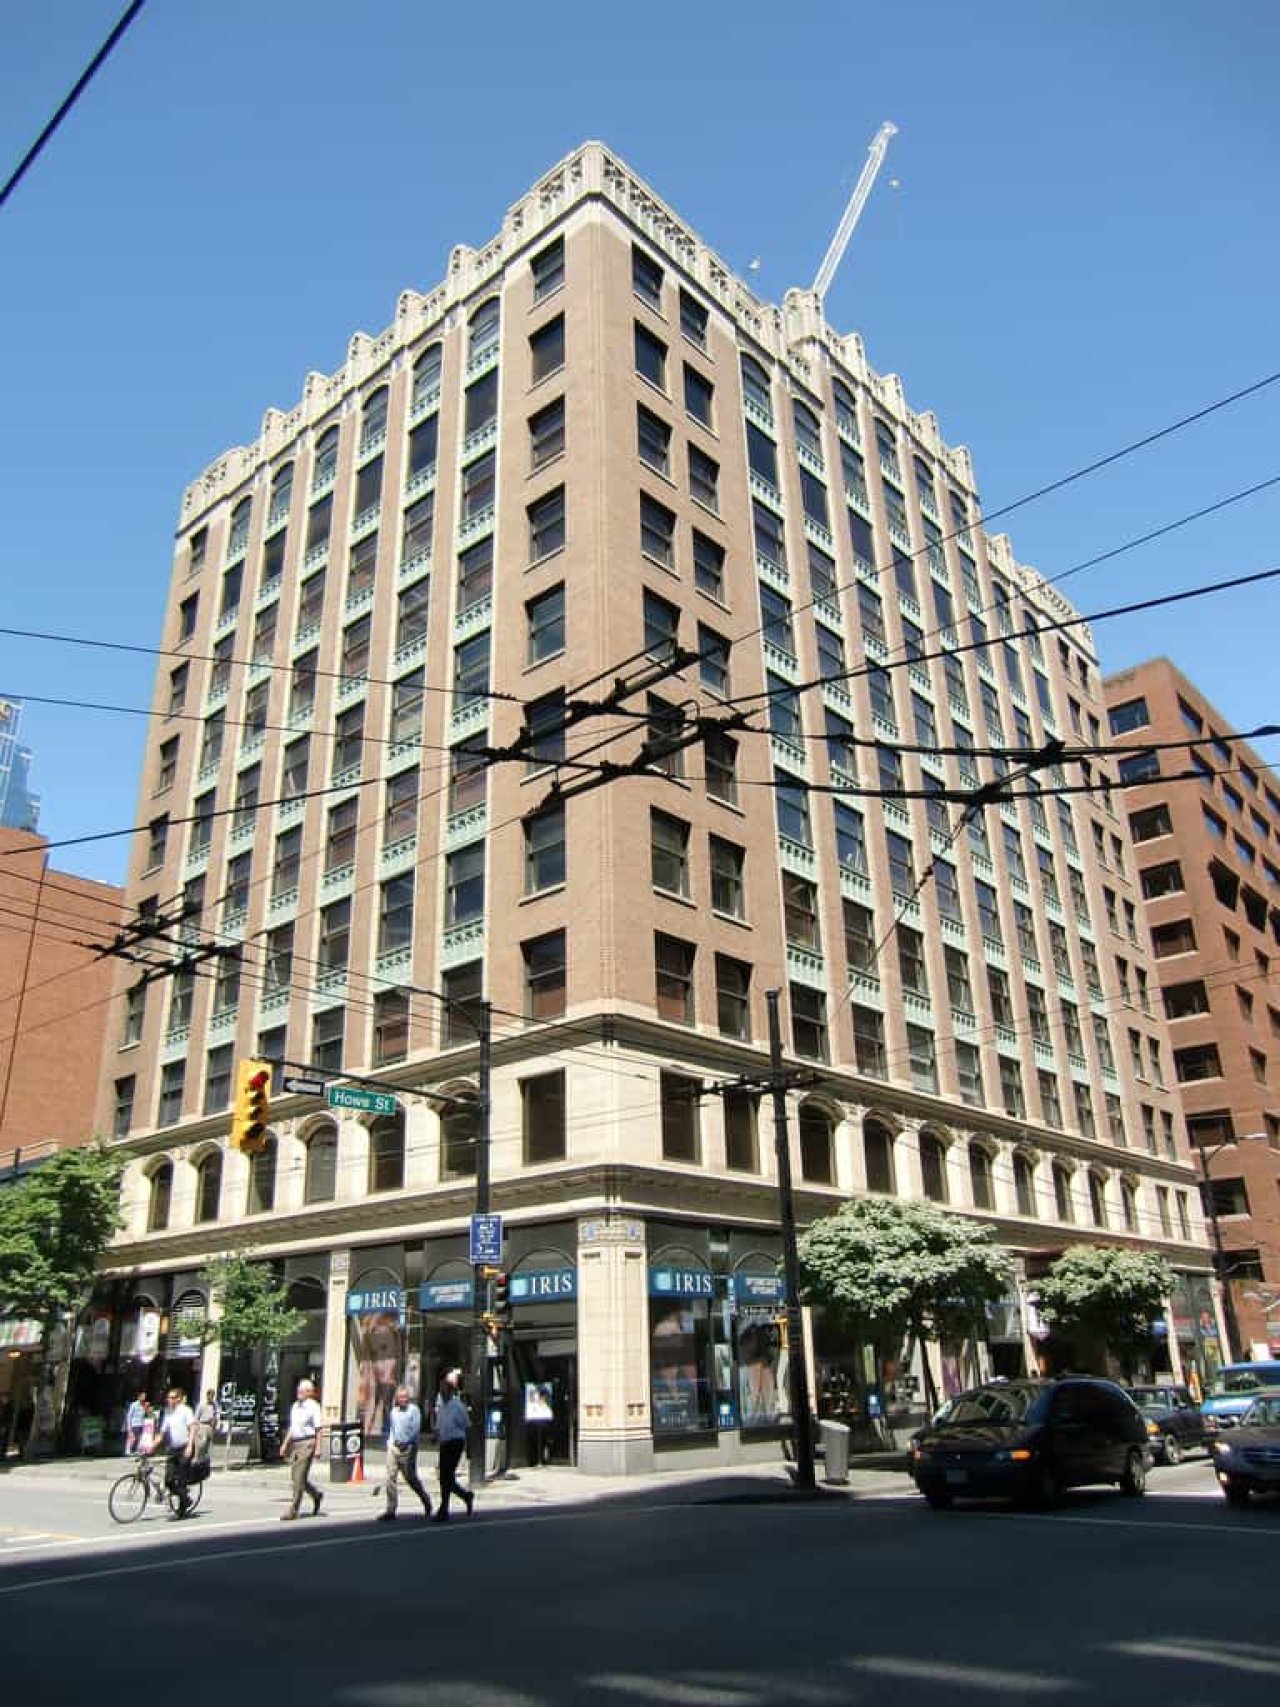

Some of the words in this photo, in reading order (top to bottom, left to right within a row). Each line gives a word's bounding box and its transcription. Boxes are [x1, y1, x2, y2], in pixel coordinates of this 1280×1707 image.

[334, 1091, 369, 1108] Howe
[374, 1096, 390, 1111] St
[530, 1272, 573, 1295] IRIS
[675, 1271, 713, 1294] IRIS
[364, 1290, 398, 1308] IRIS
